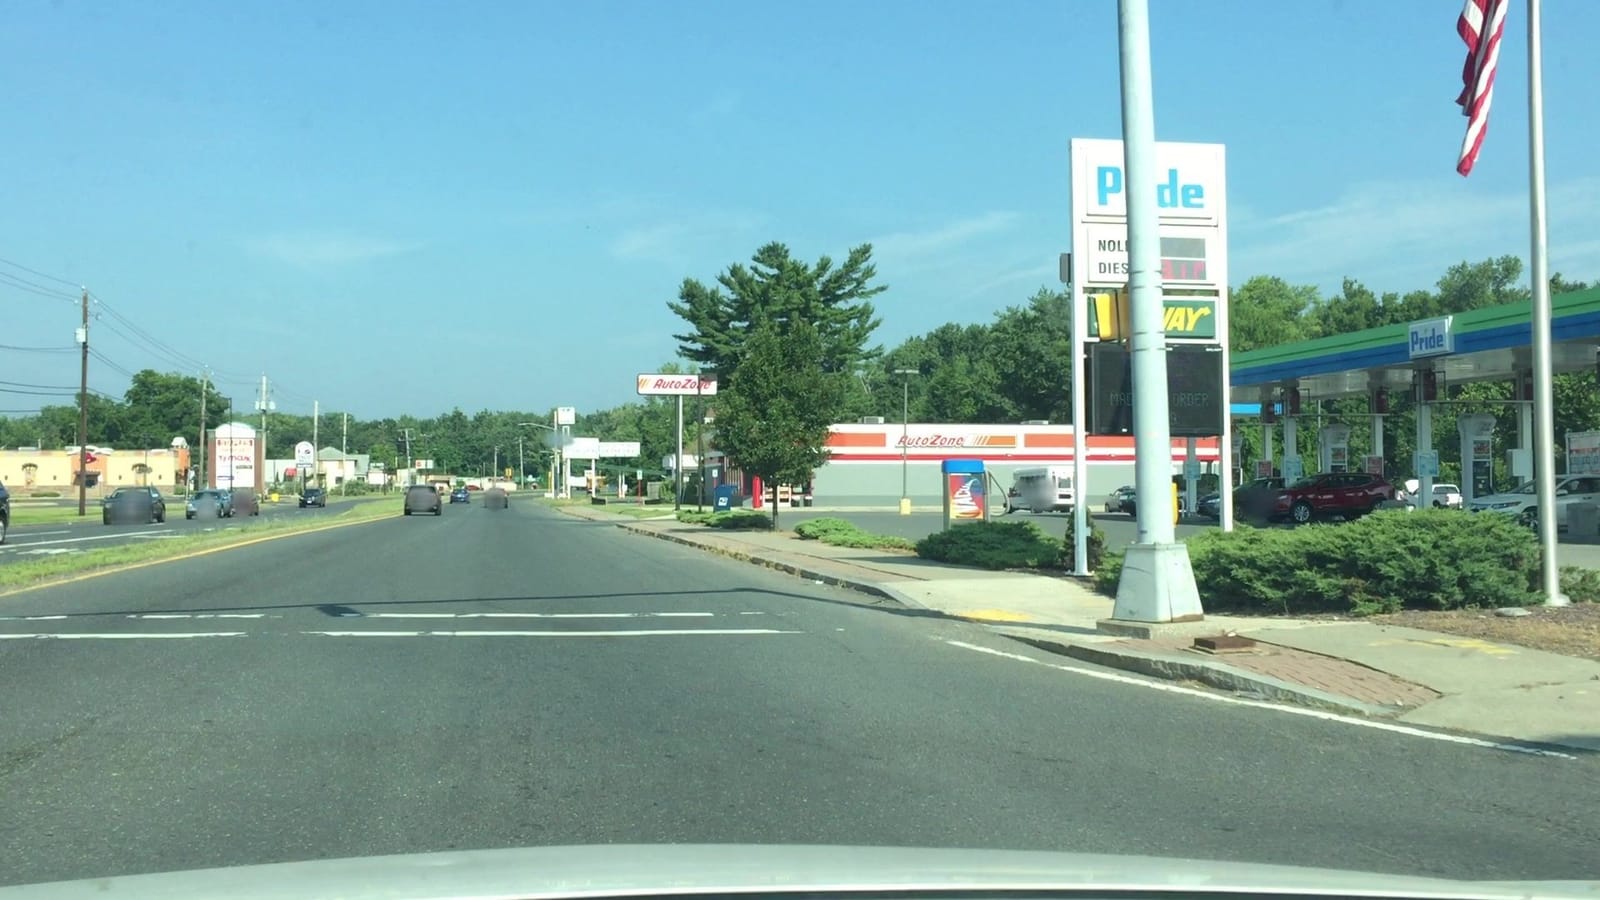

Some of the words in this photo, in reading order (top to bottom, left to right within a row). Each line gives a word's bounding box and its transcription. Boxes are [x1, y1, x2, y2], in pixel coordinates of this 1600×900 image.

[1097, 166, 1204, 208] Pde
[1098, 239, 1129, 252] NOL
[1098, 262, 1129, 275] DIES
[1410, 328, 1444, 352] Pride
[1173, 393, 1208, 405] ORDER
[897, 434, 964, 446] AutoZone
